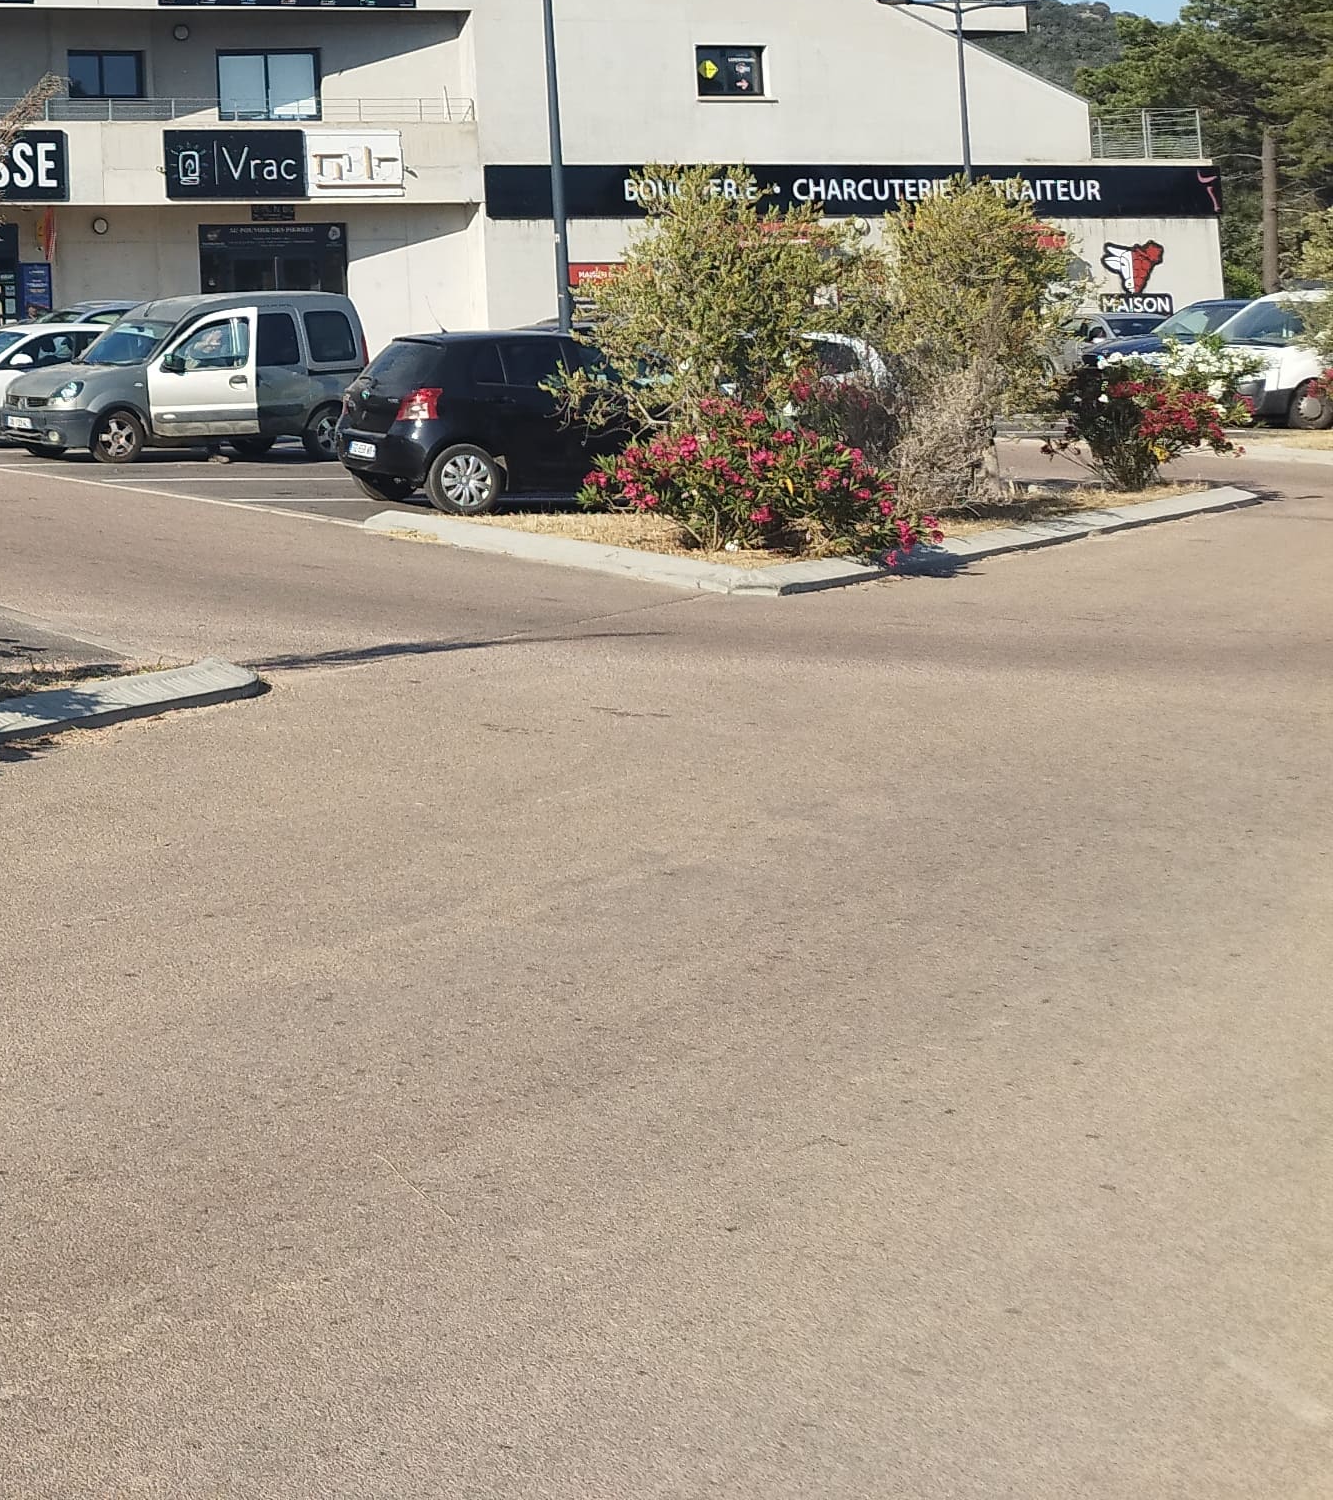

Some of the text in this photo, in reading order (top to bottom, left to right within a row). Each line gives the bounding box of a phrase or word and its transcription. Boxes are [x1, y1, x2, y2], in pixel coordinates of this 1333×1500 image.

[222, 145, 297, 180] Vrac
[624, 178, 1101, 201] BOUERE CHARCUTERIE TRAITEUR
[1102, 296, 1171, 313] MAISON
